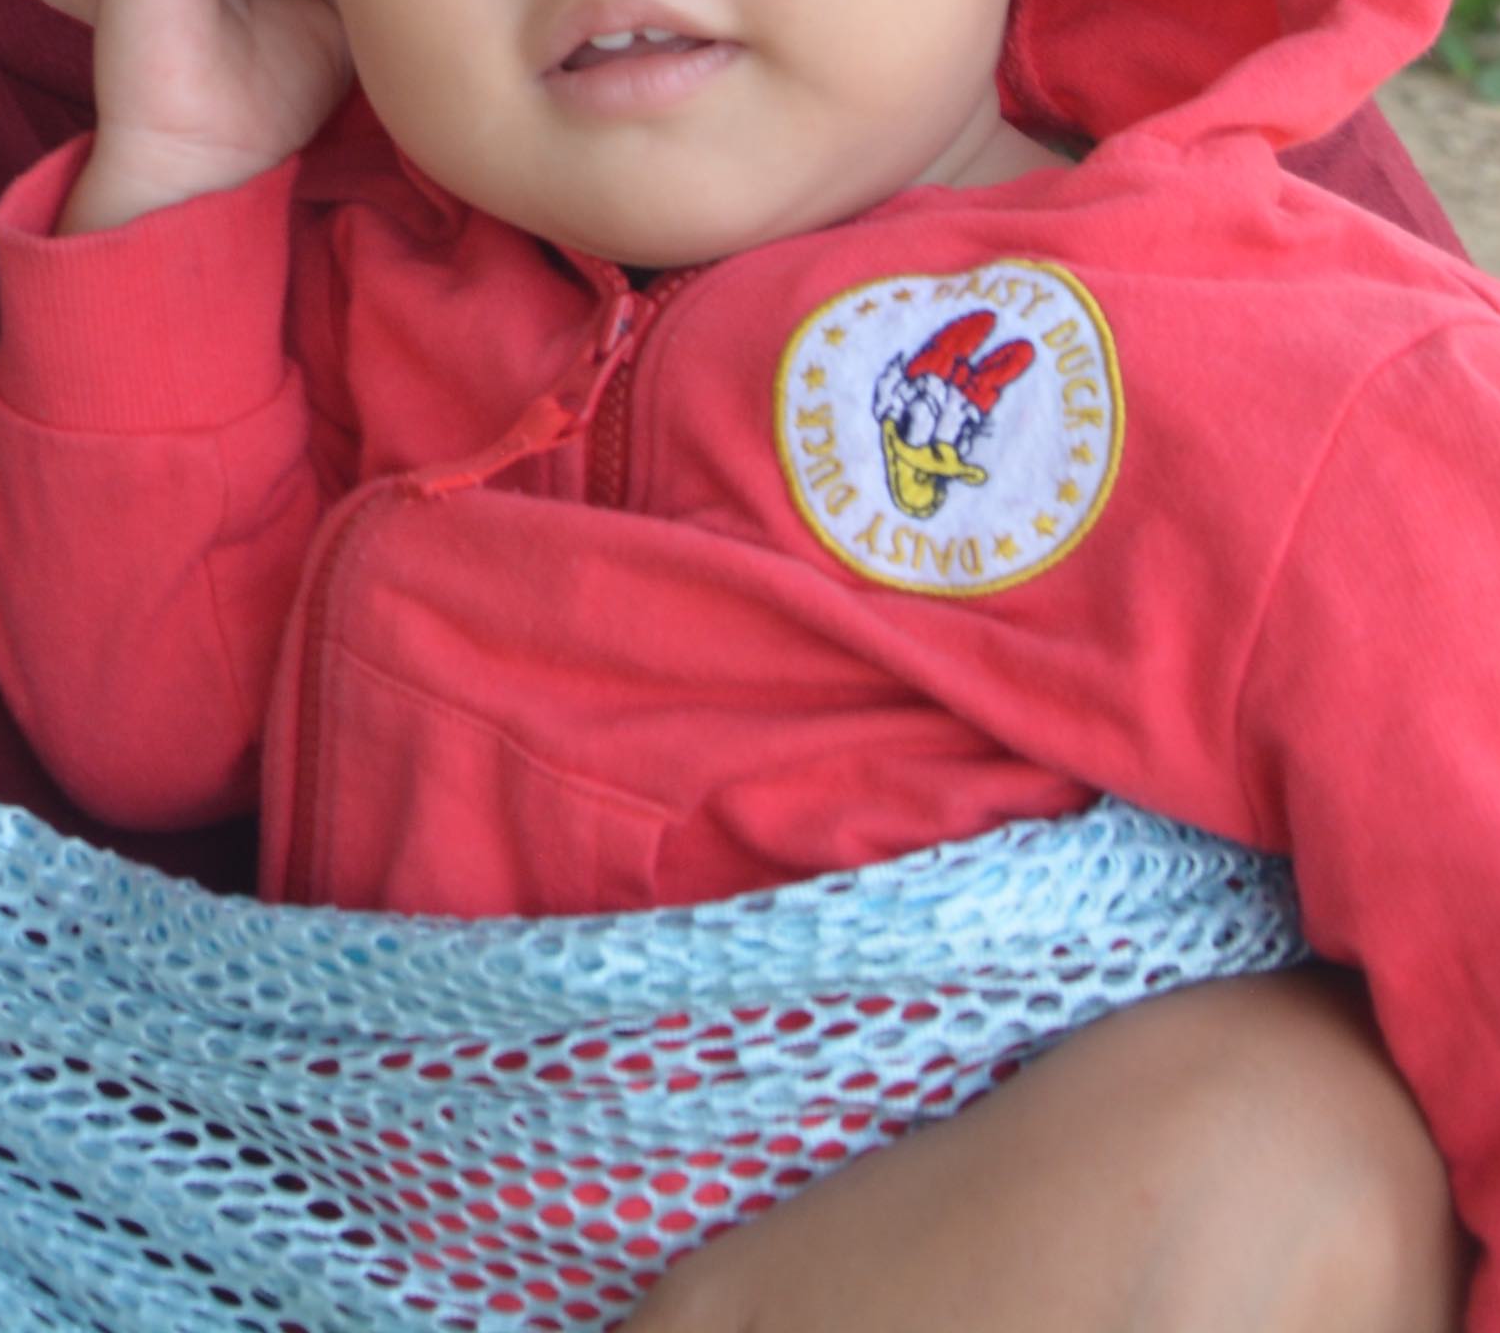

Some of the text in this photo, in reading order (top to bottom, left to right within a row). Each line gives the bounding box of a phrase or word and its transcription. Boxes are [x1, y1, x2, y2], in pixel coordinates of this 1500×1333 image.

[932, 276, 1104, 431] DAISY DUCK
[795, 403, 985, 576] DAISY DUCK
